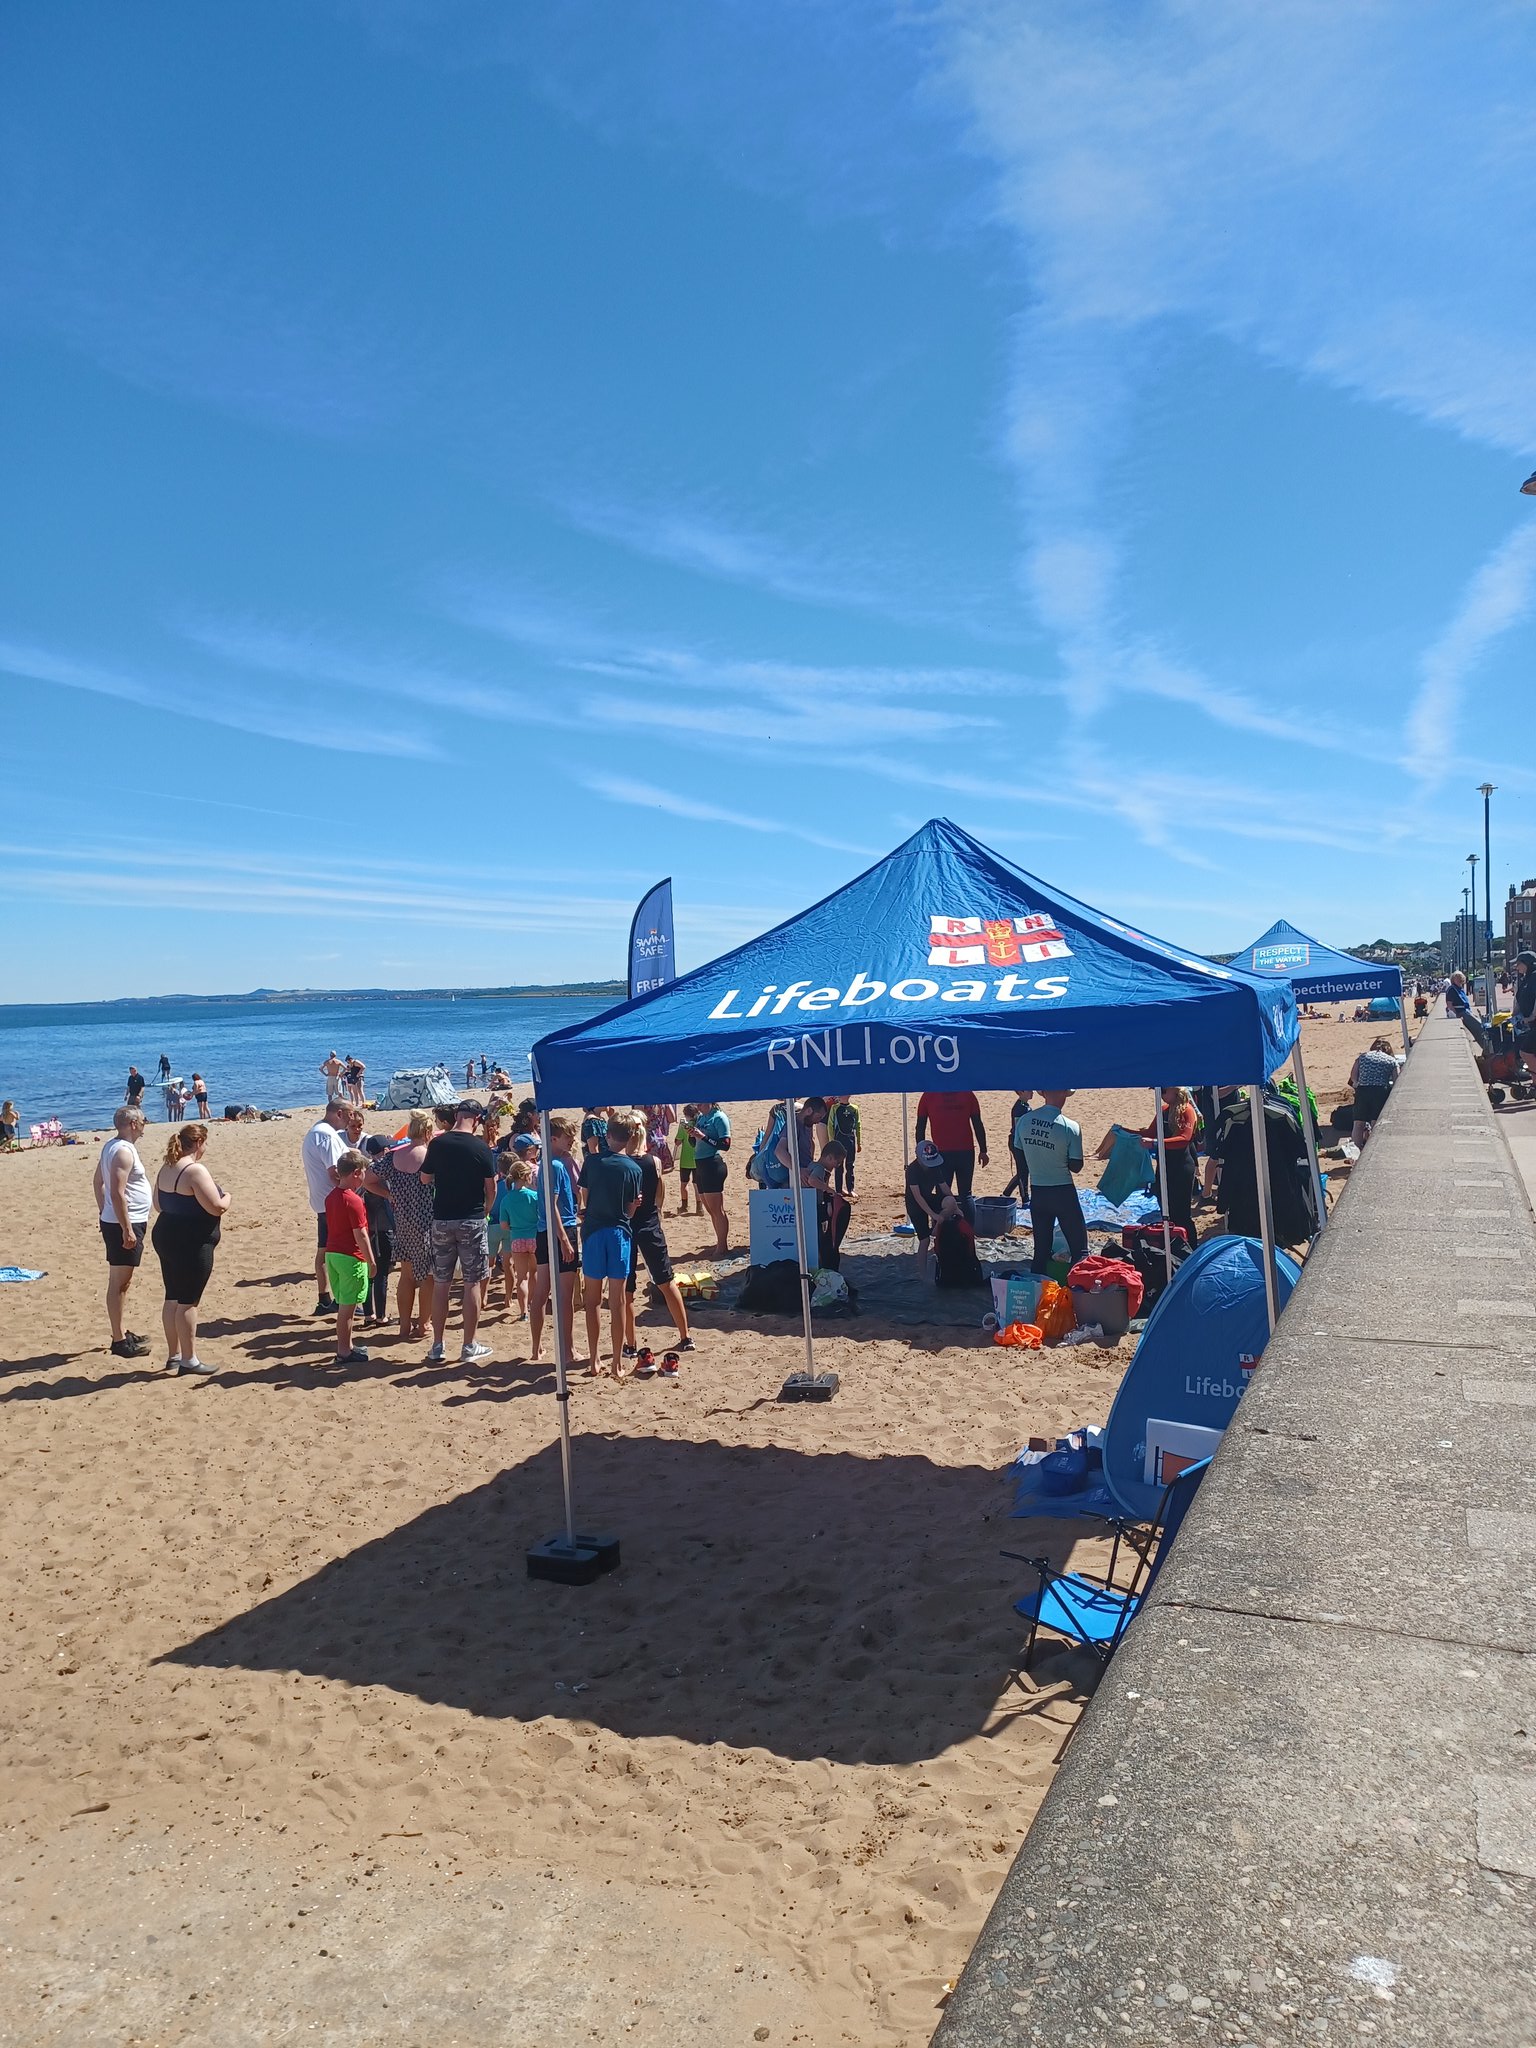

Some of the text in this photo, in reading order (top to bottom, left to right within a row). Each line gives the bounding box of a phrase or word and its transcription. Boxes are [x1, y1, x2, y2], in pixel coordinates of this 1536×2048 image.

[946, 915, 1045, 933] R N
[636, 934, 666, 948] SWIM
[640, 945, 664, 957] SAFE
[948, 944, 1051, 964] L I
[1259, 946, 1302, 958] RESPECT
[1259, 955, 1302, 966] THE WATER
[707, 972, 1070, 1020] Lifeboats
[767, 1026, 960, 1073] RNLI.org
[1031, 1118, 1055, 1129] SWIM
[1030, 1128, 1050, 1139] SAFE
[1023, 1137, 1056, 1150] TEACHER
[771, 1213, 796, 1224] SAFE
